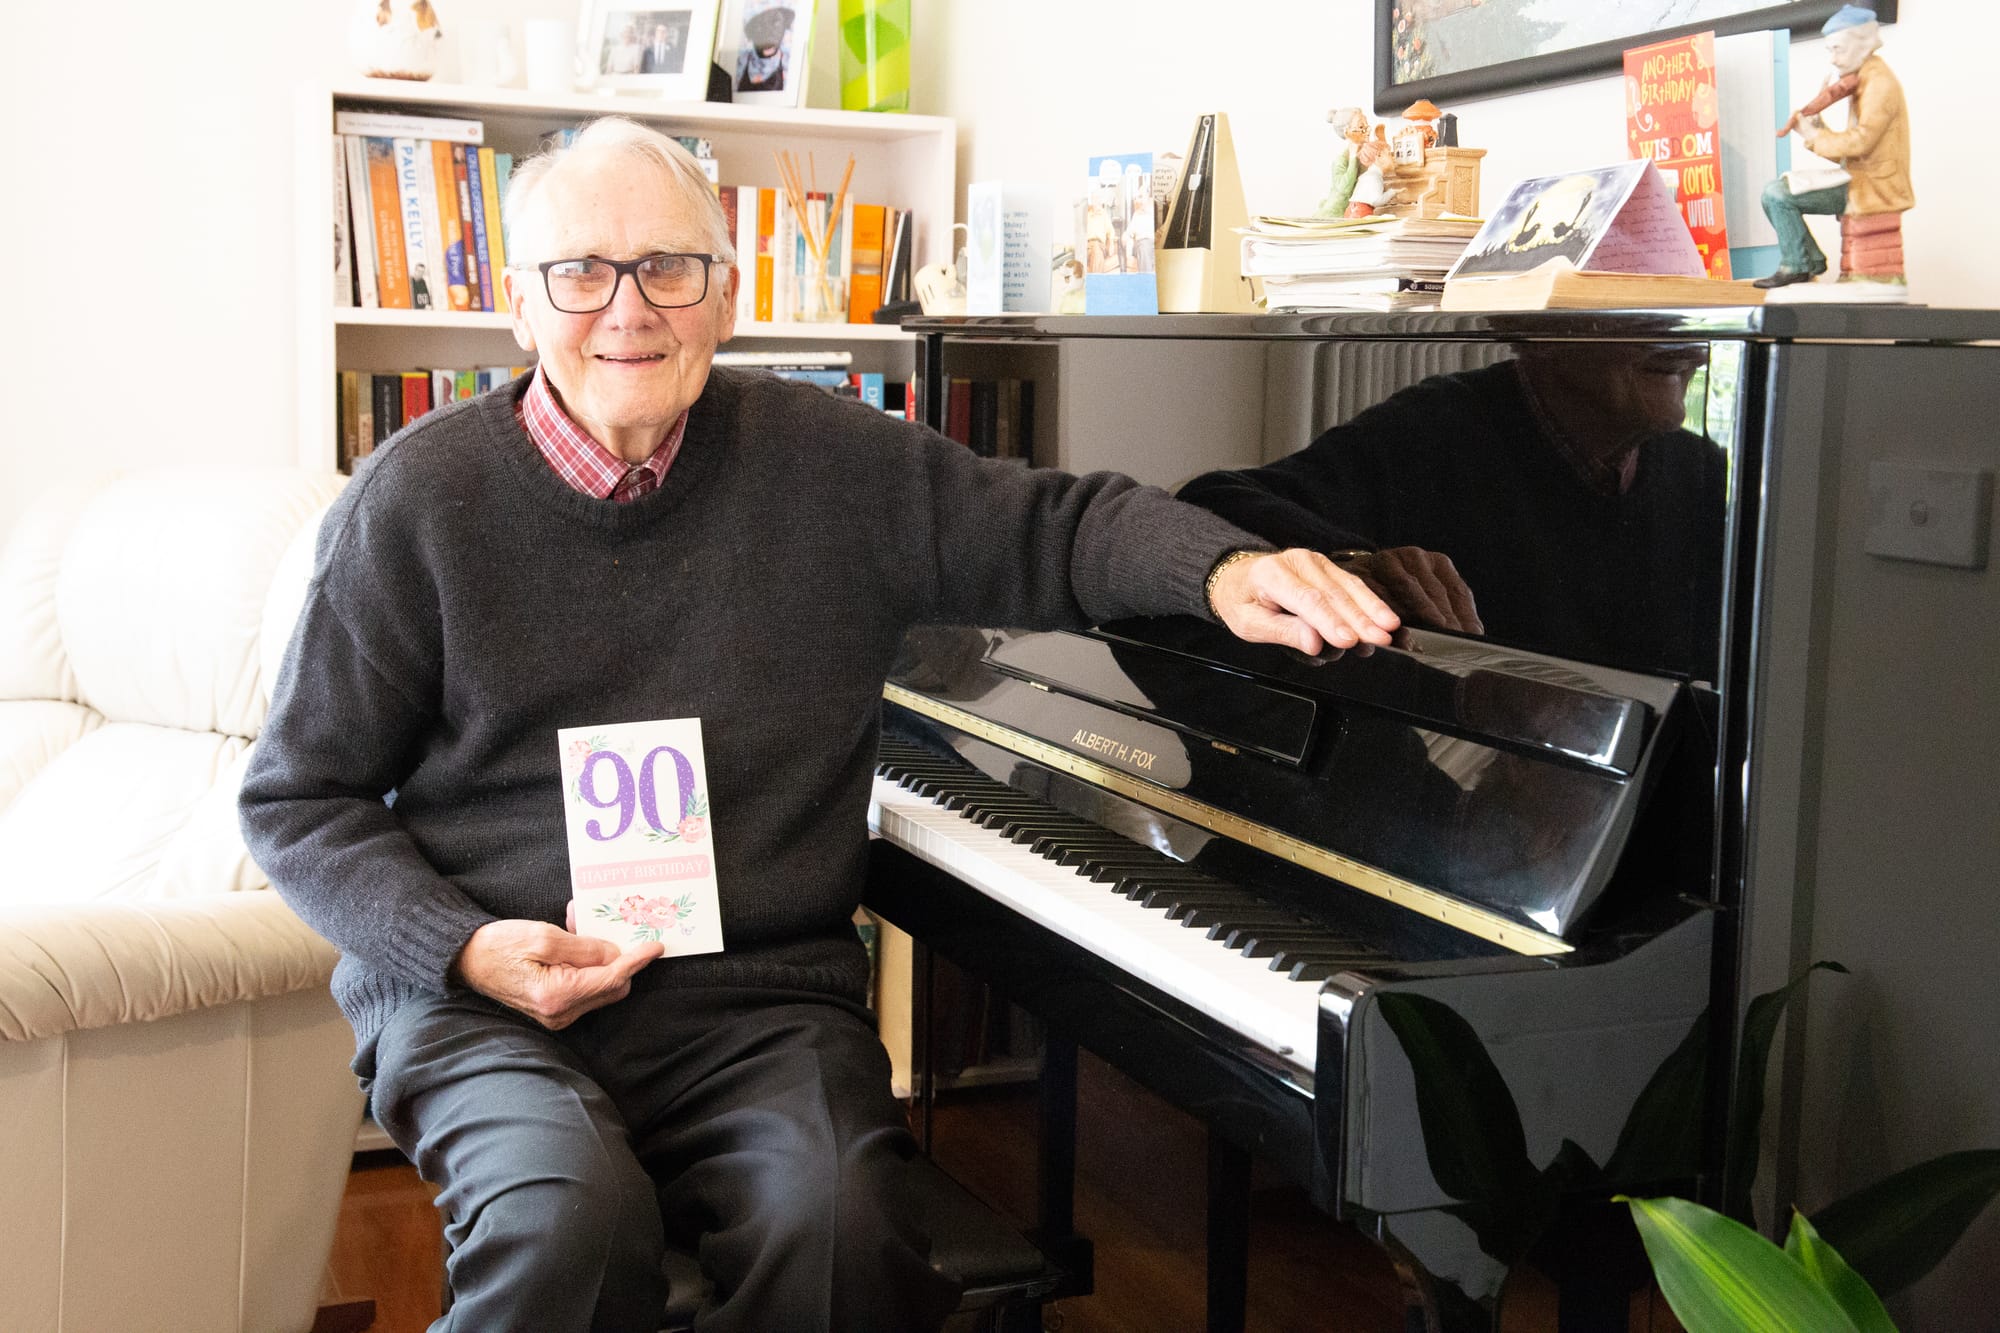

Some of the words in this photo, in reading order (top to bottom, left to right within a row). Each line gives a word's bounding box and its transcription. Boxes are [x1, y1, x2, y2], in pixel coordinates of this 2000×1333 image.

[1642, 52, 1694, 84] ANOTHER
[1642, 76, 1696, 106] BIRTHDAY!
[1638, 131, 1713, 161] WISDOM
[401, 145, 417, 190] PAUL
[1683, 164, 1715, 195] COMES
[406, 196, 423, 249] KELLY
[1687, 198, 1715, 228] WITH
[1071, 729, 1119, 756] ALBERT
[1116, 744, 1128, 761] H.
[1129, 749, 1157, 770] FOX
[579, 745, 696, 842] 90
[581, 867, 630, 885] HAPPY
[634, 859, 705, 878] BIRTHDAY
